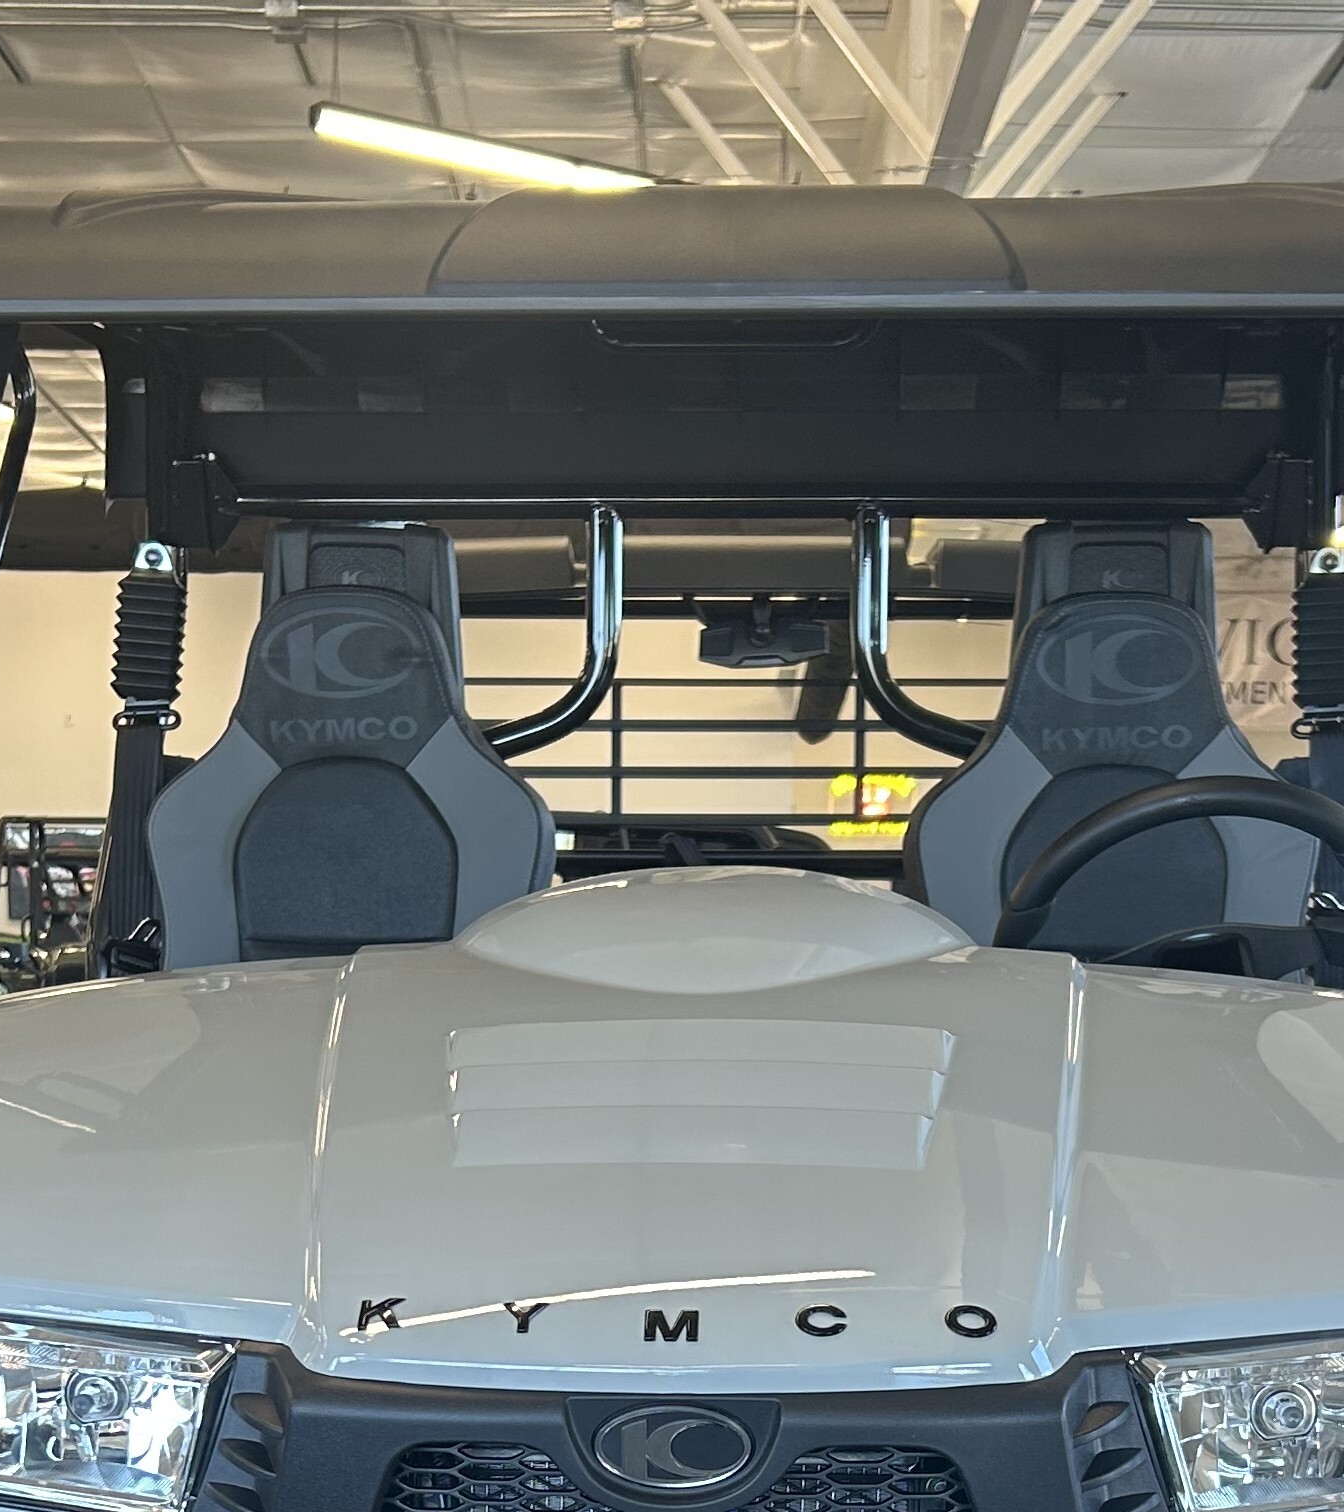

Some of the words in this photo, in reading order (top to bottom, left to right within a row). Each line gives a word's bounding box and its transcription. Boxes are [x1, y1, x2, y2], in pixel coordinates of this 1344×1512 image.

[270, 715, 418, 743] KYMCO
[1042, 724, 1193, 750] KYMCO
[357, 1297, 998, 1343] KYMCO
